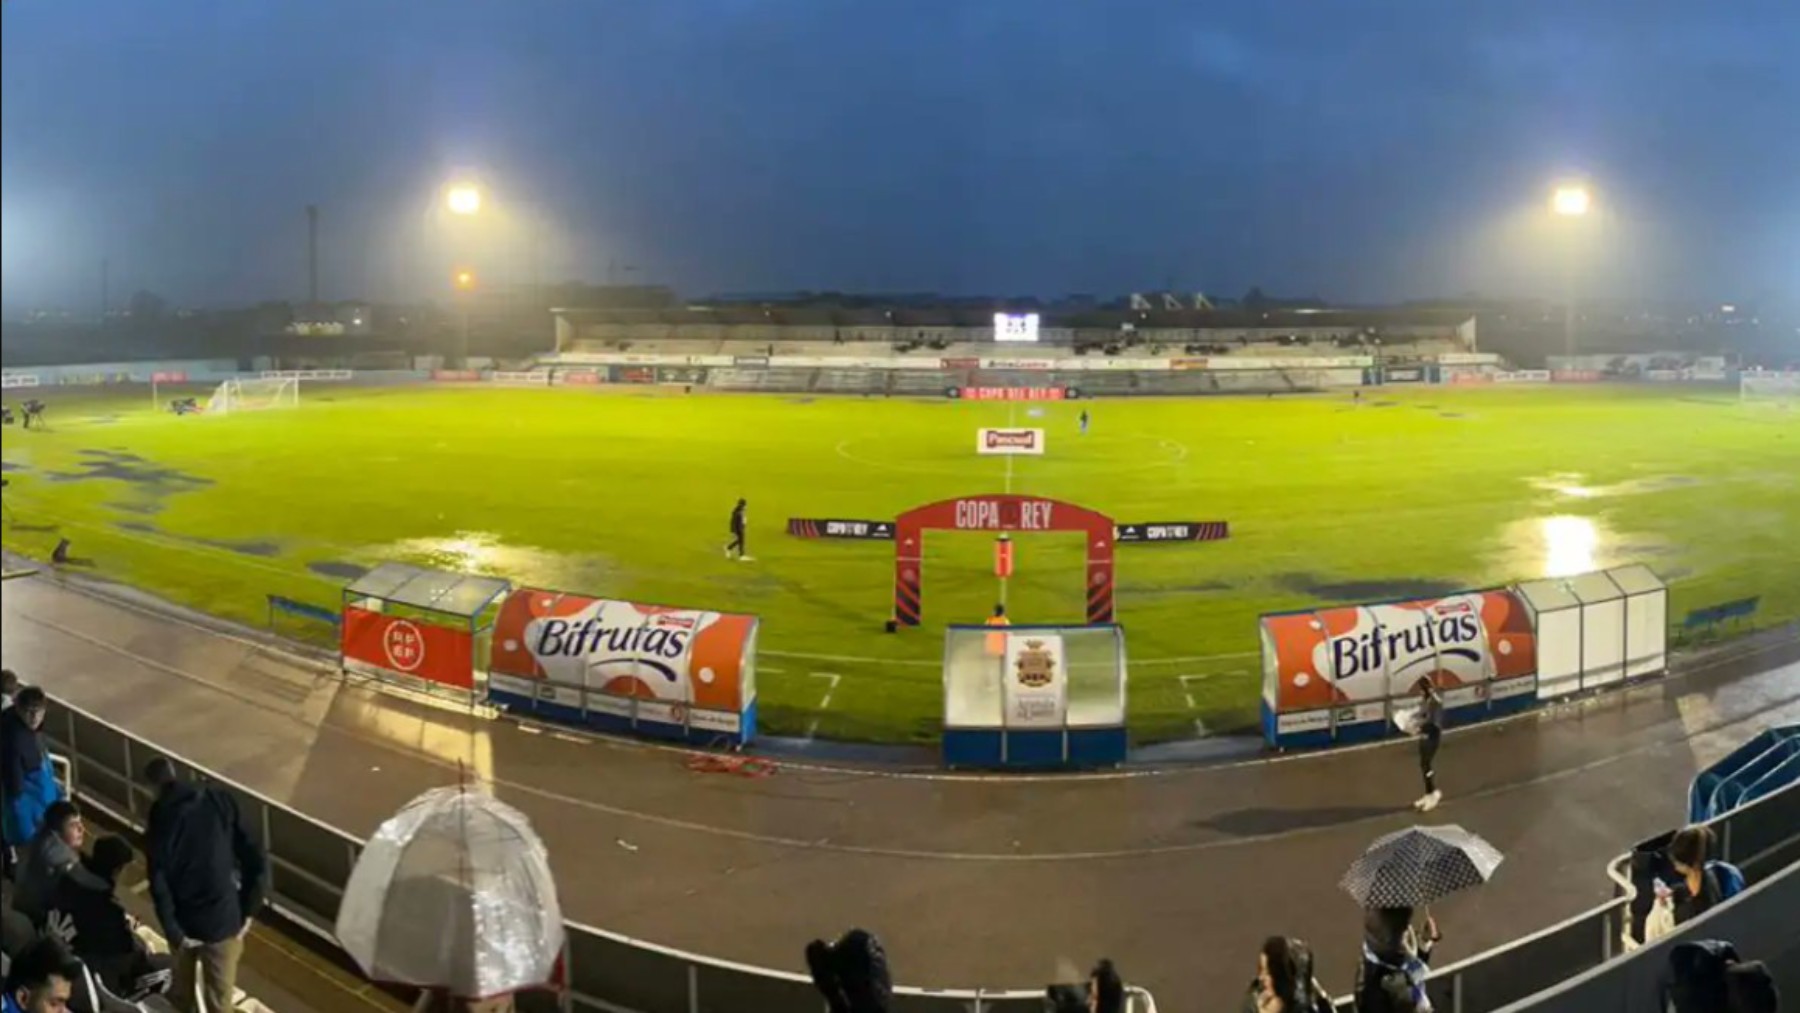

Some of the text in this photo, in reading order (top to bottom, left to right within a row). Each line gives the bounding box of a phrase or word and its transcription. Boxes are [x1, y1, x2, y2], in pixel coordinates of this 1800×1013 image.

[957, 500, 1053, 529] COPA REY
[538, 617, 687, 658] Bifrutas
[1334, 614, 1478, 680] Bifrutas
